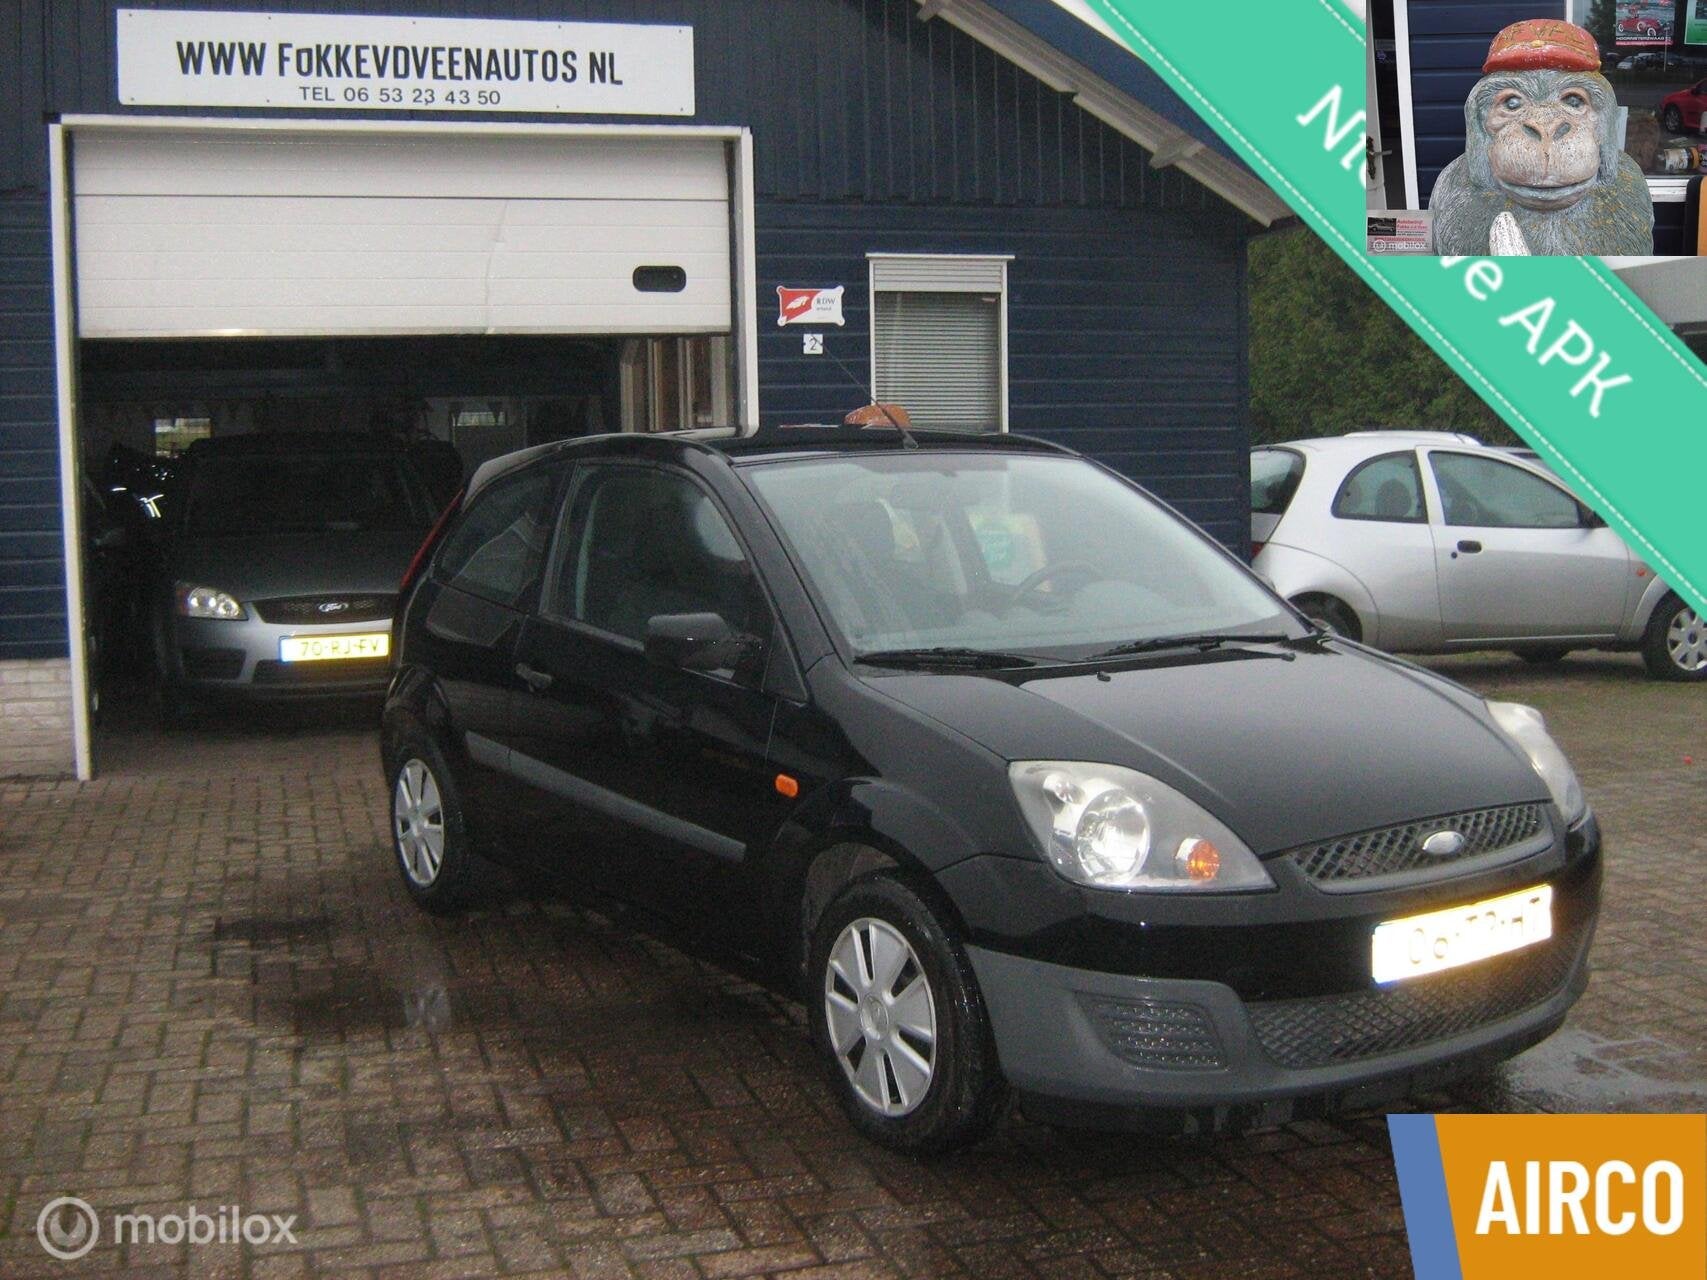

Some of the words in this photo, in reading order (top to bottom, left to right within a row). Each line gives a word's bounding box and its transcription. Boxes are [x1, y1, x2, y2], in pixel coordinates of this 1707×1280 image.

[176, 41, 267, 75] WWW
[589, 52, 623, 86] NL
[299, 86, 335, 102] TEL
[343, 87, 369, 102] 06
[378, 88, 403, 103] 53
[412, 88, 436, 105] 23
[445, 90, 471, 105] 43
[477, 90, 501, 105] 50
[809, 336, 818, 351] 2
